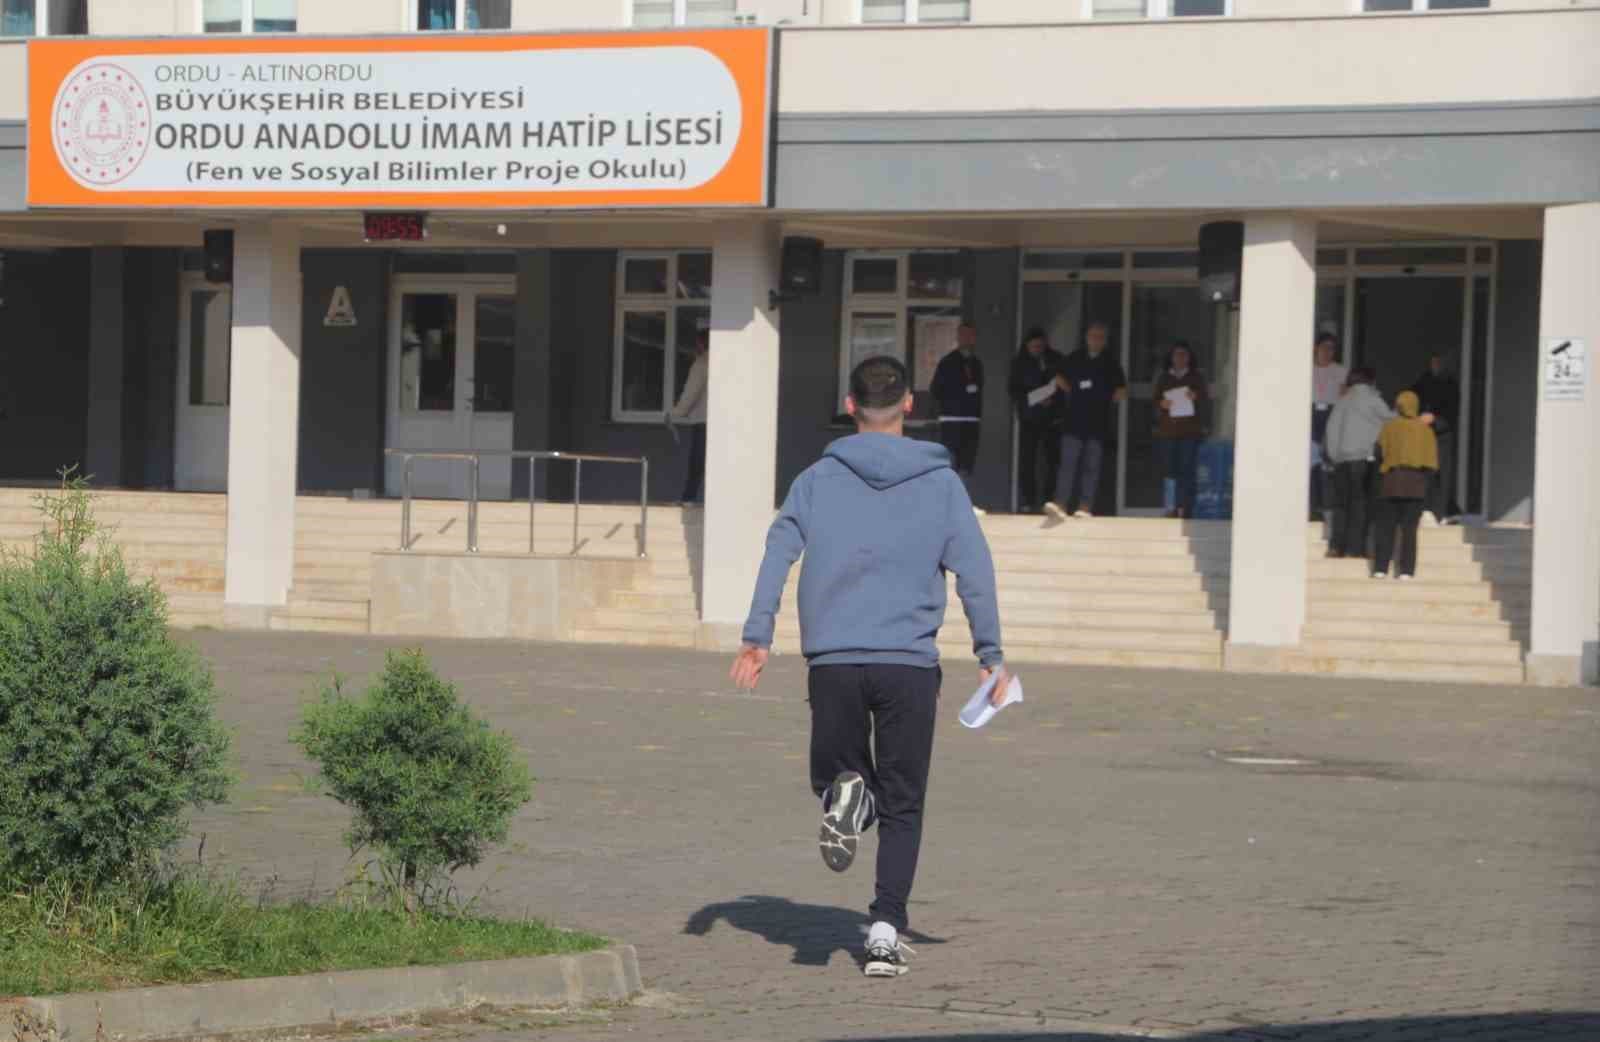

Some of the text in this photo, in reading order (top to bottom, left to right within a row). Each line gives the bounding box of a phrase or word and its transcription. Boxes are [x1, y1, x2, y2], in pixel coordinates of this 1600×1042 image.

[154, 64, 221, 82] ORDU
[241, 63, 373, 82] ALTINORDU
[155, 86, 525, 116] BÜYÜKŞEHİR BELEDİYESİ
[154, 123, 245, 150] ORDU
[254, 122, 412, 150] ANADOLU
[421, 115, 513, 150] İMAM
[522, 113, 617, 148] HATİP
[625, 110, 723, 147] LİSESİ
[186, 158, 687, 186] (Fen ve Sosyal Bilimler Proje Okulu)
